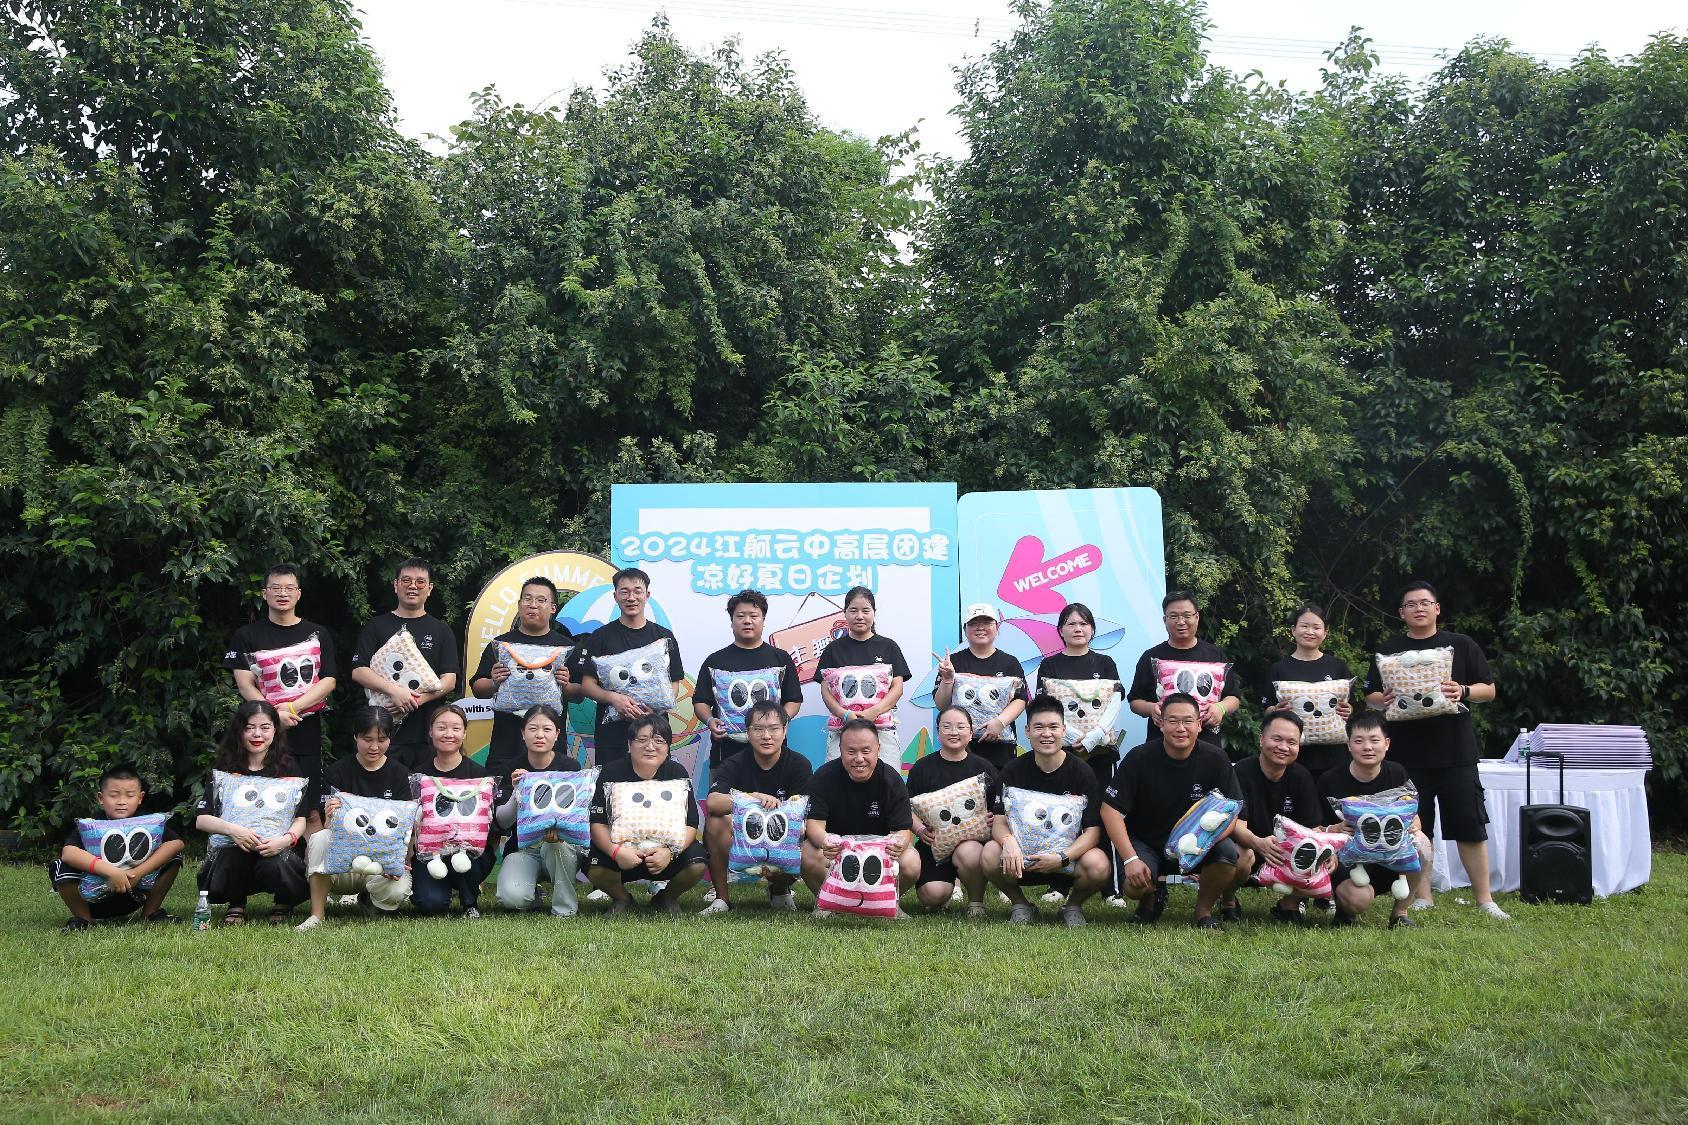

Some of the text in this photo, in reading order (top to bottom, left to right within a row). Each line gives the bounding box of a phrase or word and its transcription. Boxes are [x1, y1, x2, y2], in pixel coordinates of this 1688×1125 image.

[696, 563, 873, 591] 凉好夏日企划
[1012, 552, 1093, 593] WELCOME
[480, 586, 518, 652] ELLO
[465, 704, 485, 713] with
